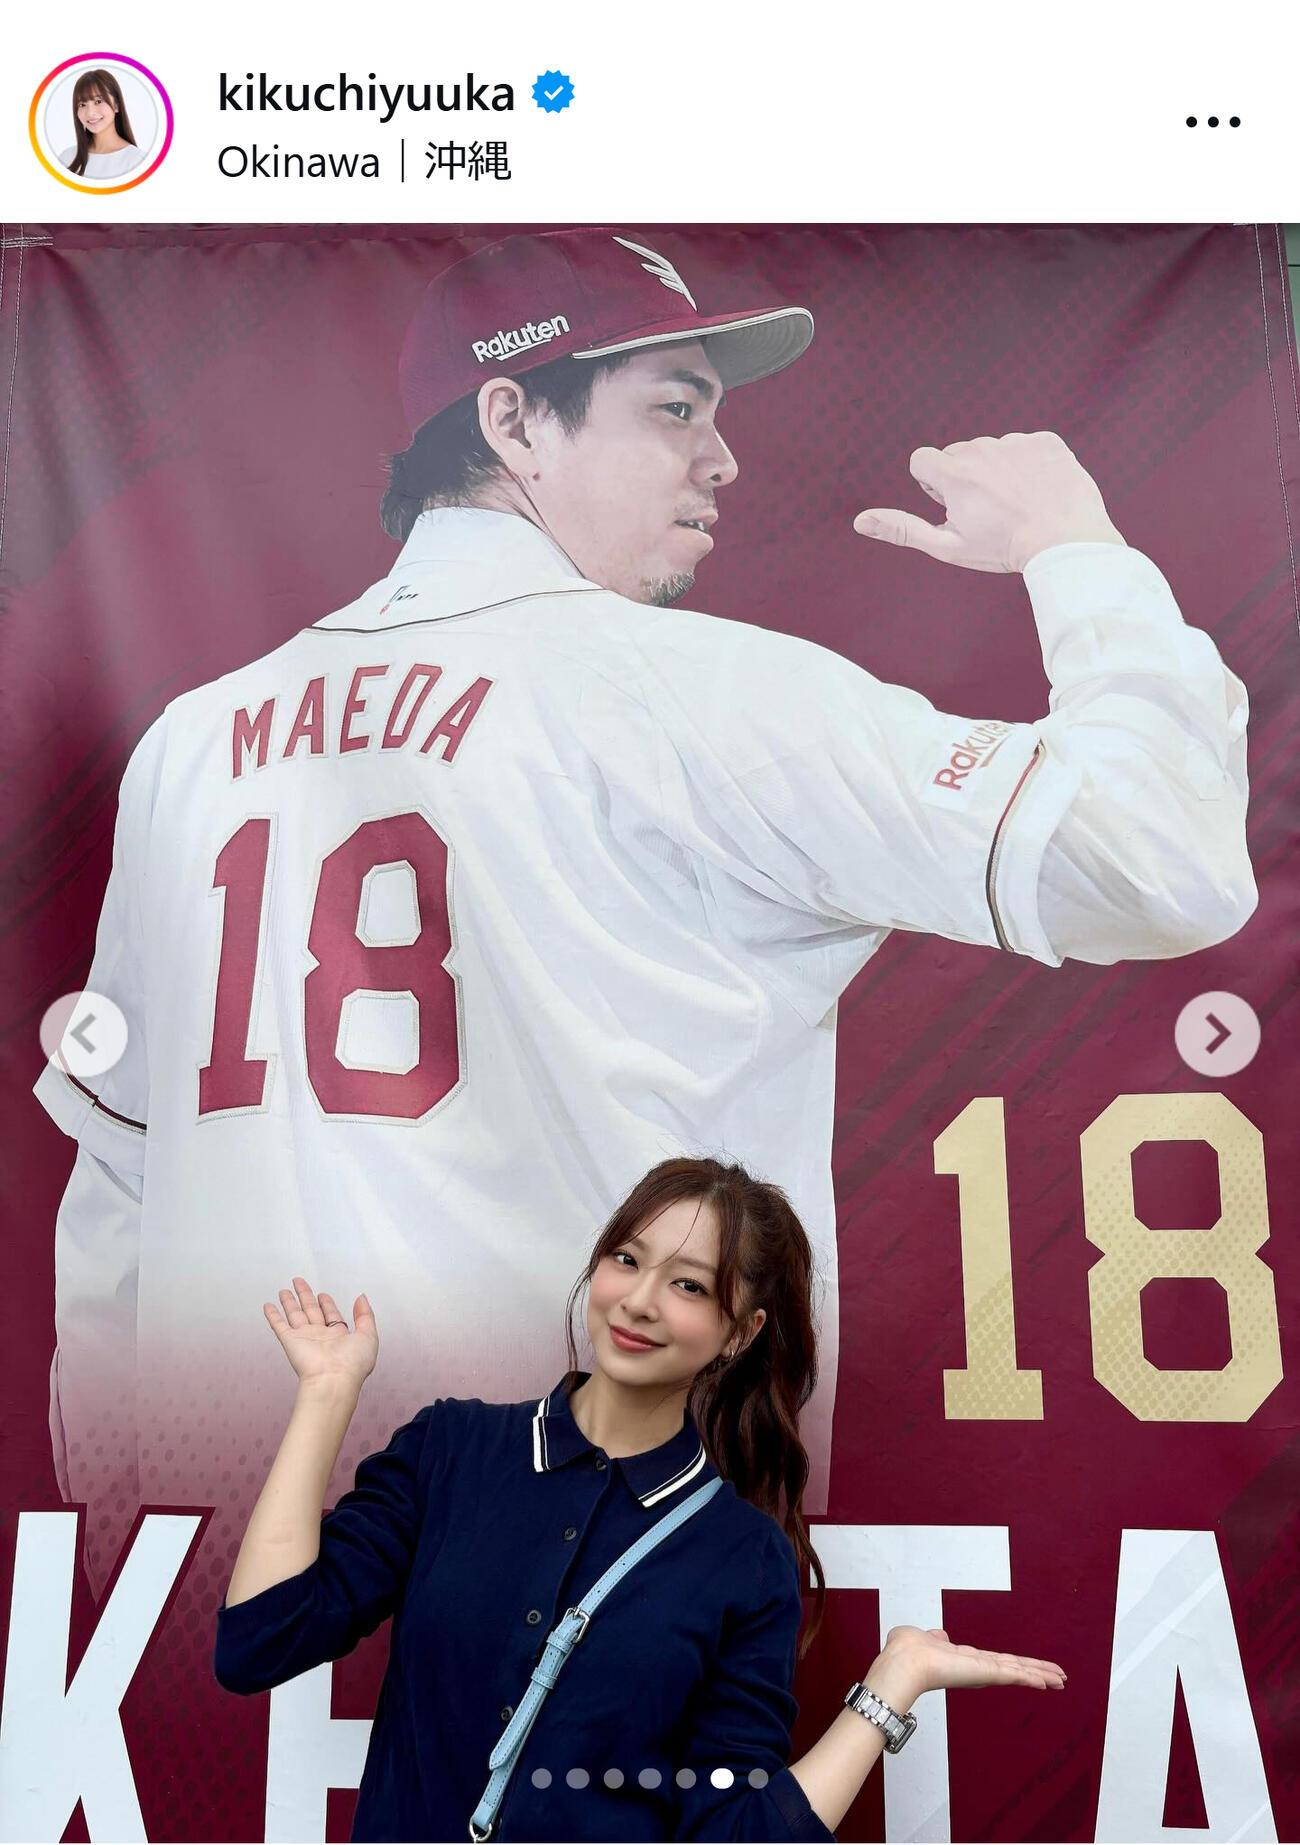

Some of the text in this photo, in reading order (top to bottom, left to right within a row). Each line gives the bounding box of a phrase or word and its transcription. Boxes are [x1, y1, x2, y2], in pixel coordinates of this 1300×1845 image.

[471, 314, 571, 364] Rakuten
[231, 662, 495, 781] MAEDA
[197, 808, 464, 1123] 18
[933, 1091, 1285, 1423] 18
